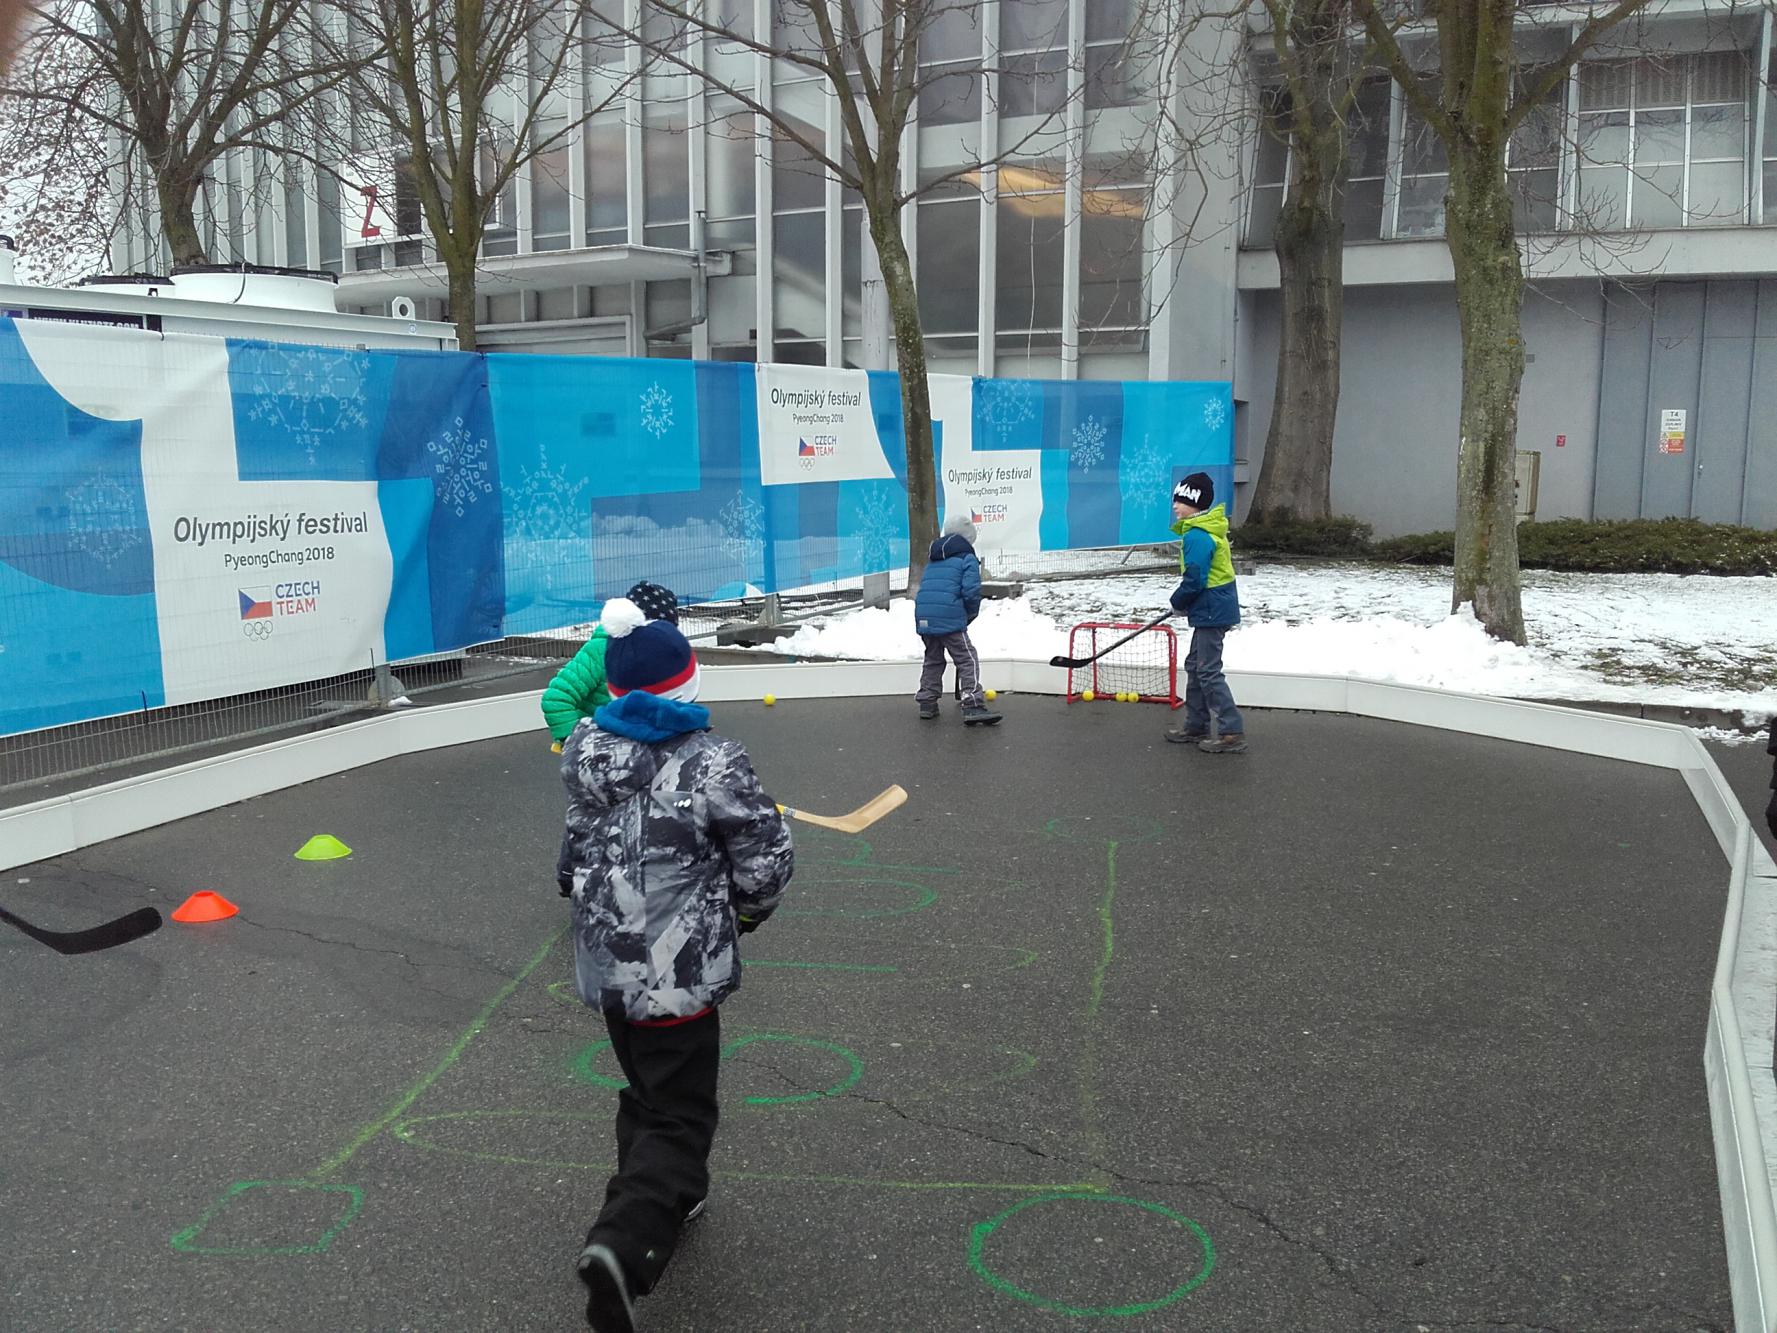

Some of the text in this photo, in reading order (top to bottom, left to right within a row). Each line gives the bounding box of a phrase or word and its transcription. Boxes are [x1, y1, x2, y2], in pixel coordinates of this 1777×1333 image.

[360, 185, 381, 238] Z
[771, 388, 861, 408] Olympijský festival
[792, 413, 844, 424] PyeongChang 2018
[814, 435, 837, 446] CZECH
[815, 446, 834, 456] TEAM
[948, 466, 1032, 484] Olympijský festival
[999, 486, 1013, 494] 2018
[983, 504, 1008, 514] CZECH
[983, 514, 1005, 523] TEAM
[174, 511, 368, 546] Olympijský festival
[224, 546, 335, 571] PyeongChang 2018
[275, 580, 320, 599] CZECH
[276, 598, 316, 616] TEAM
